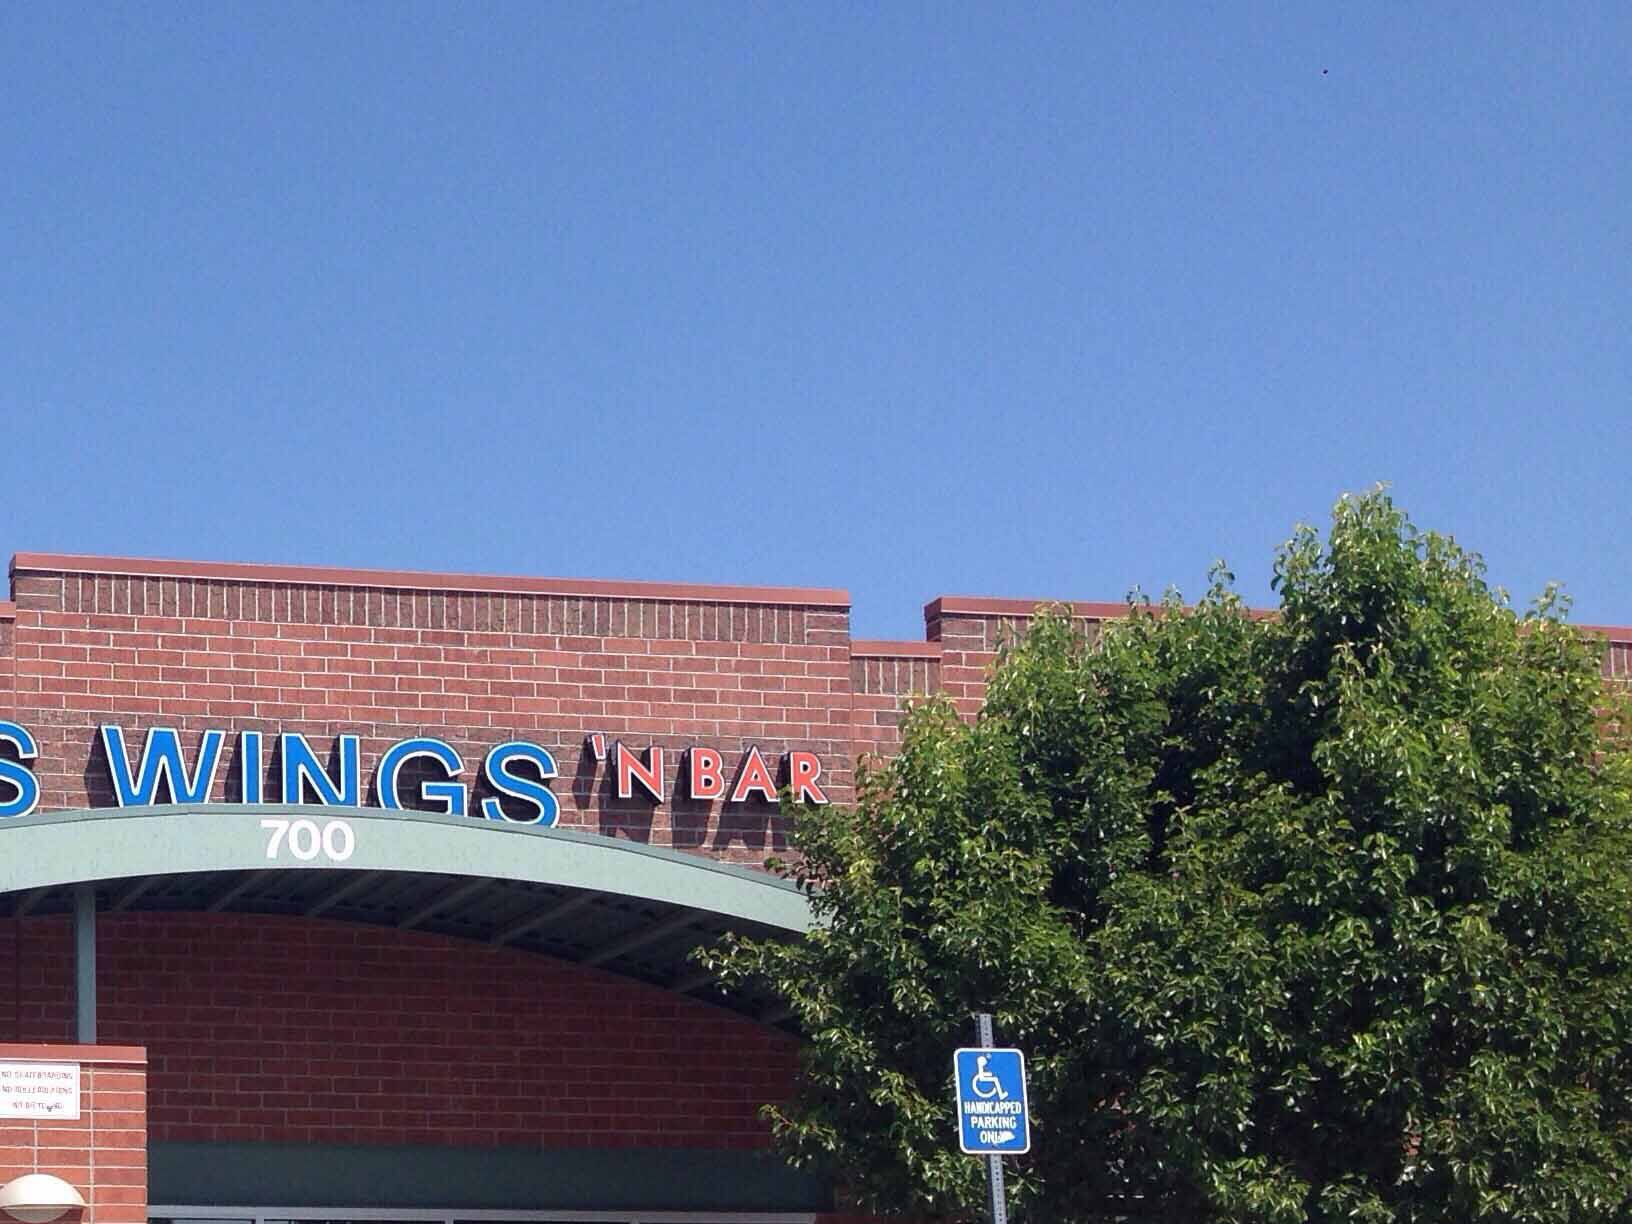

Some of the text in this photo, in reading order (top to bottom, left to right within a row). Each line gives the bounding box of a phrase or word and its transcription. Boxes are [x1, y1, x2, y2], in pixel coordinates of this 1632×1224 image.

[100, 725, 561, 830] WINGS
[690, 745, 829, 804] BAR
[259, 819, 356, 862] 700
[964, 1101, 1022, 1114] HANDICAPPED
[971, 1115, 1017, 1129] PARKING
